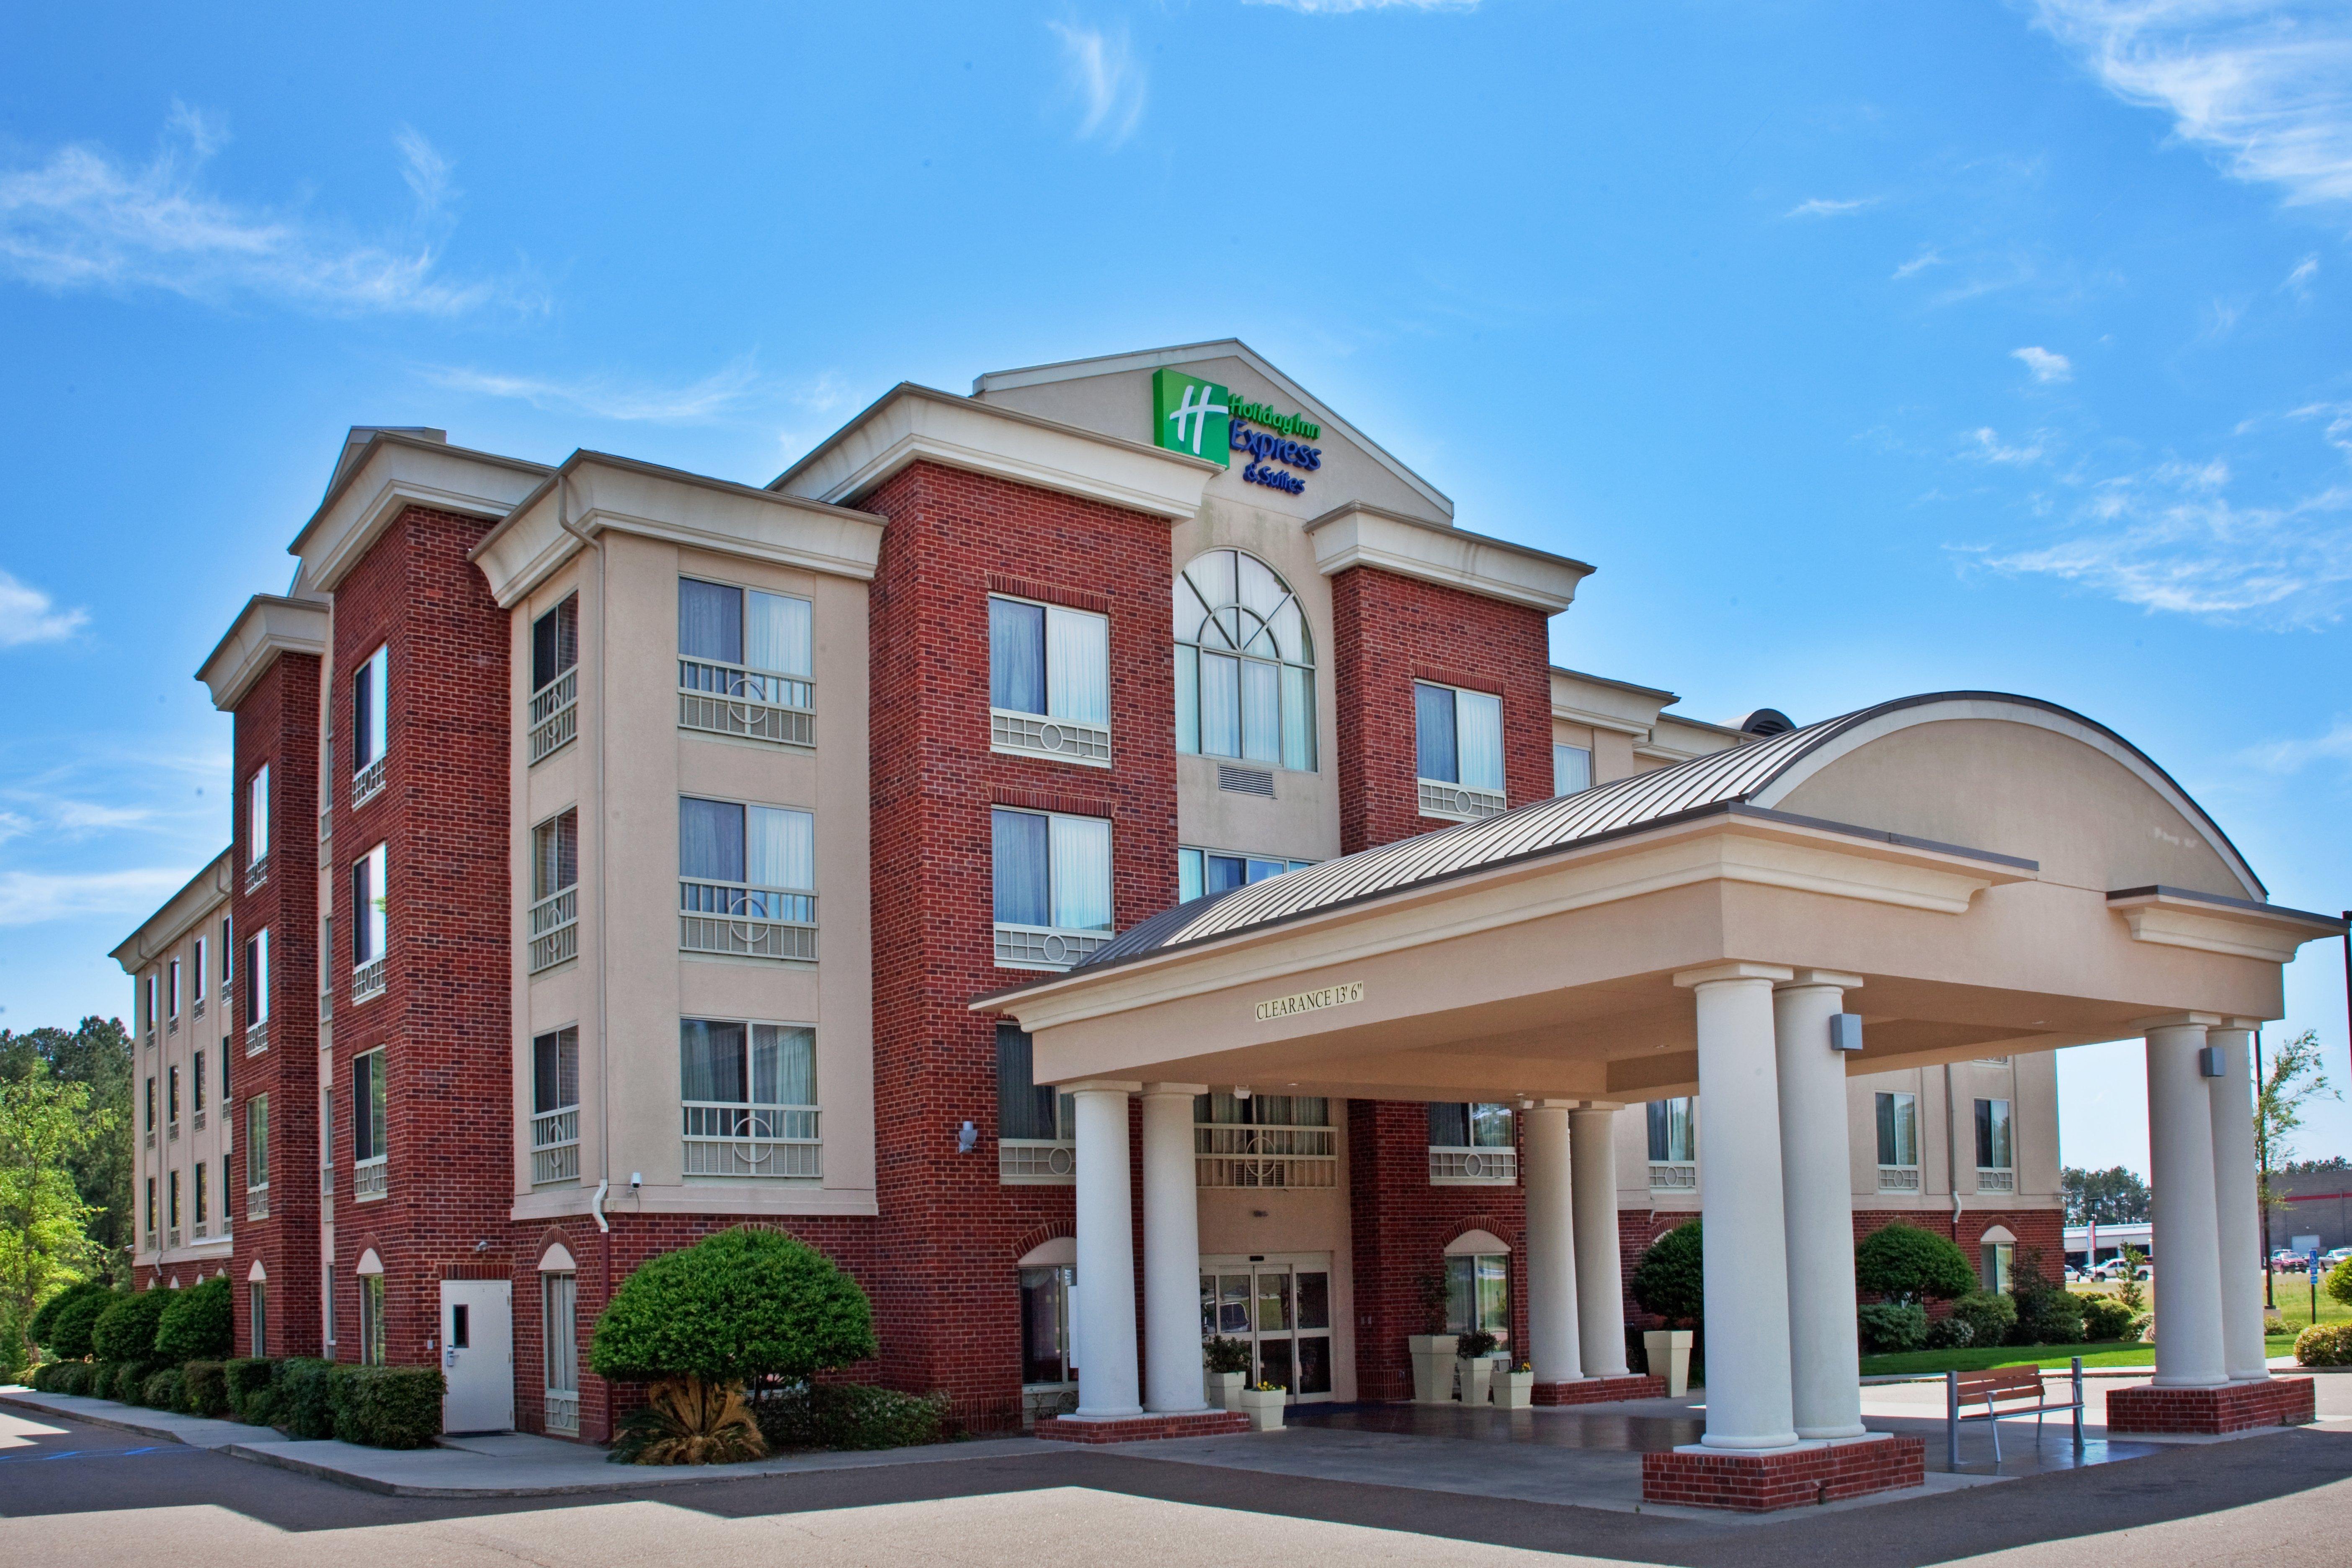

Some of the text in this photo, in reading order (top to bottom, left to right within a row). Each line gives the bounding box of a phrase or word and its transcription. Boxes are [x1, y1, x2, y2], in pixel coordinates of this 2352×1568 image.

[1230, 393, 1320, 439] Holiday Inn
[1230, 419, 1322, 471] Express
[1243, 462, 1305, 494] & Suites
[1257, 983, 1362, 1019] CLEARANCE 13' 6"
